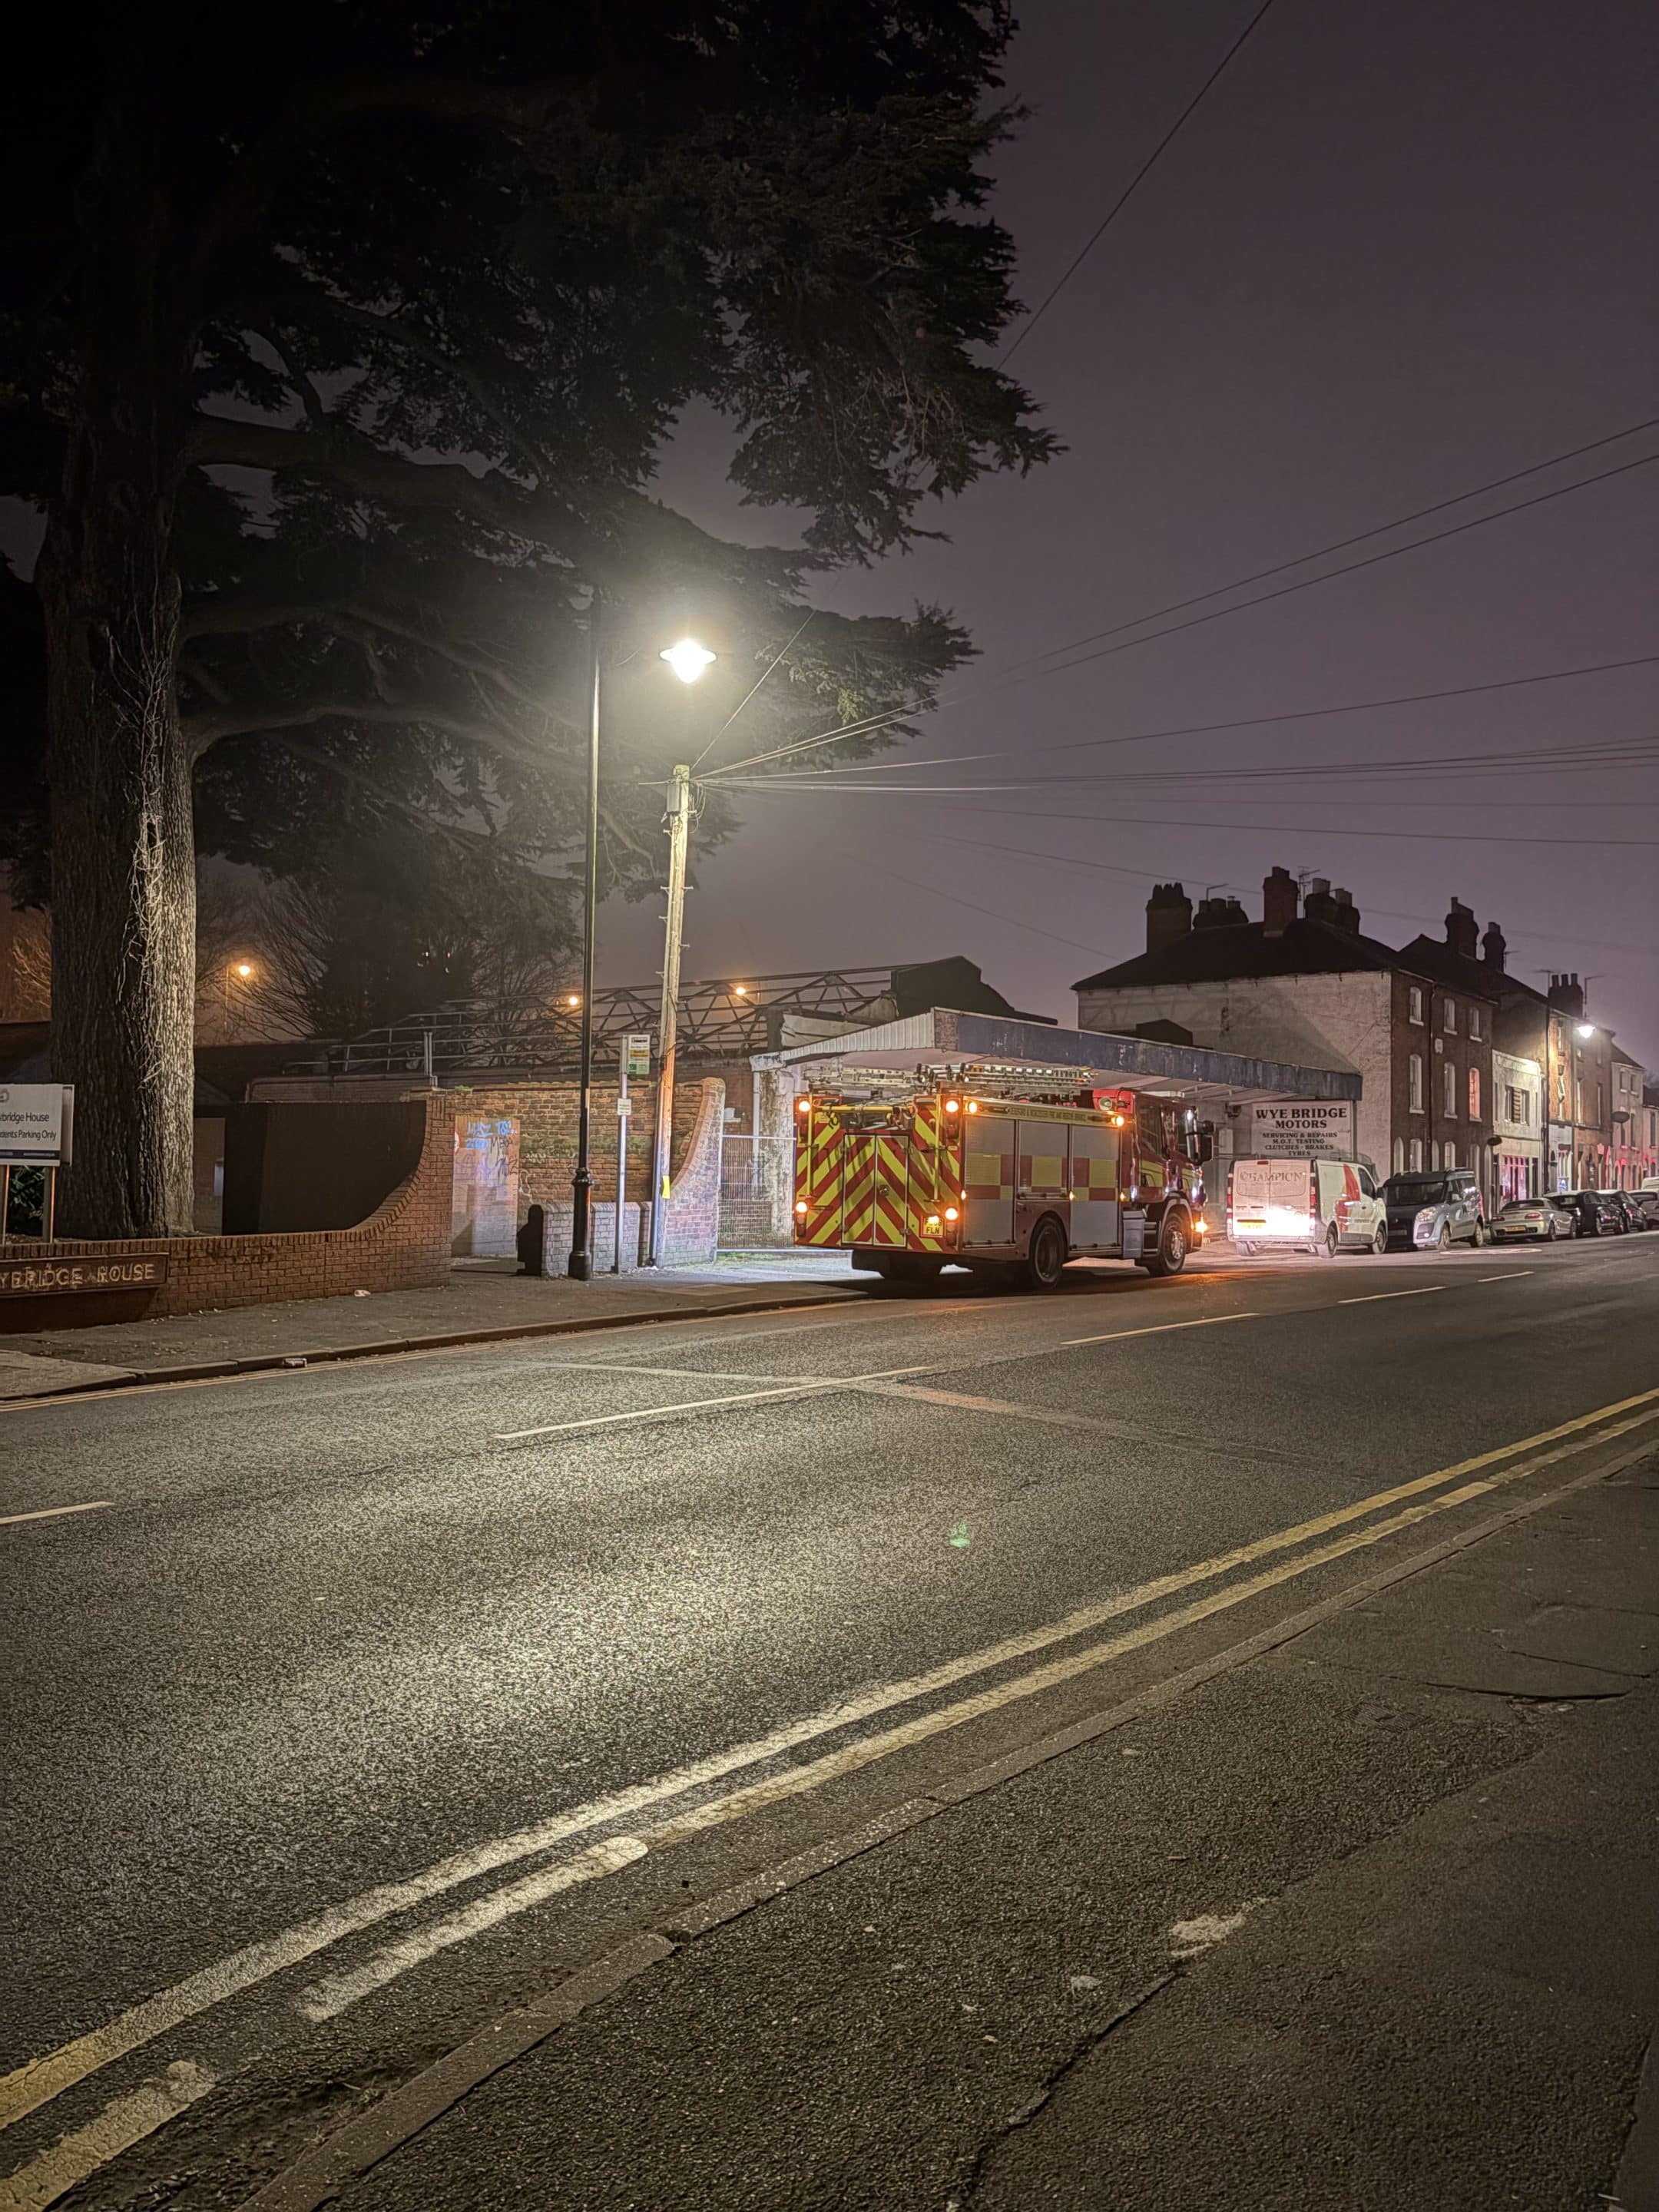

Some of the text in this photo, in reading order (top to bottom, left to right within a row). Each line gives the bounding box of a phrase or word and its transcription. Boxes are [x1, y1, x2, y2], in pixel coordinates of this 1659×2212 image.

[25, 1112, 49, 1121] House
[1256, 1108, 1347, 1118] WYE BRIDGE
[1275, 1120, 1327, 1128] MOTORS
[18, 1130, 41, 1141] Parking
[41, 1130, 56, 1141] Only
